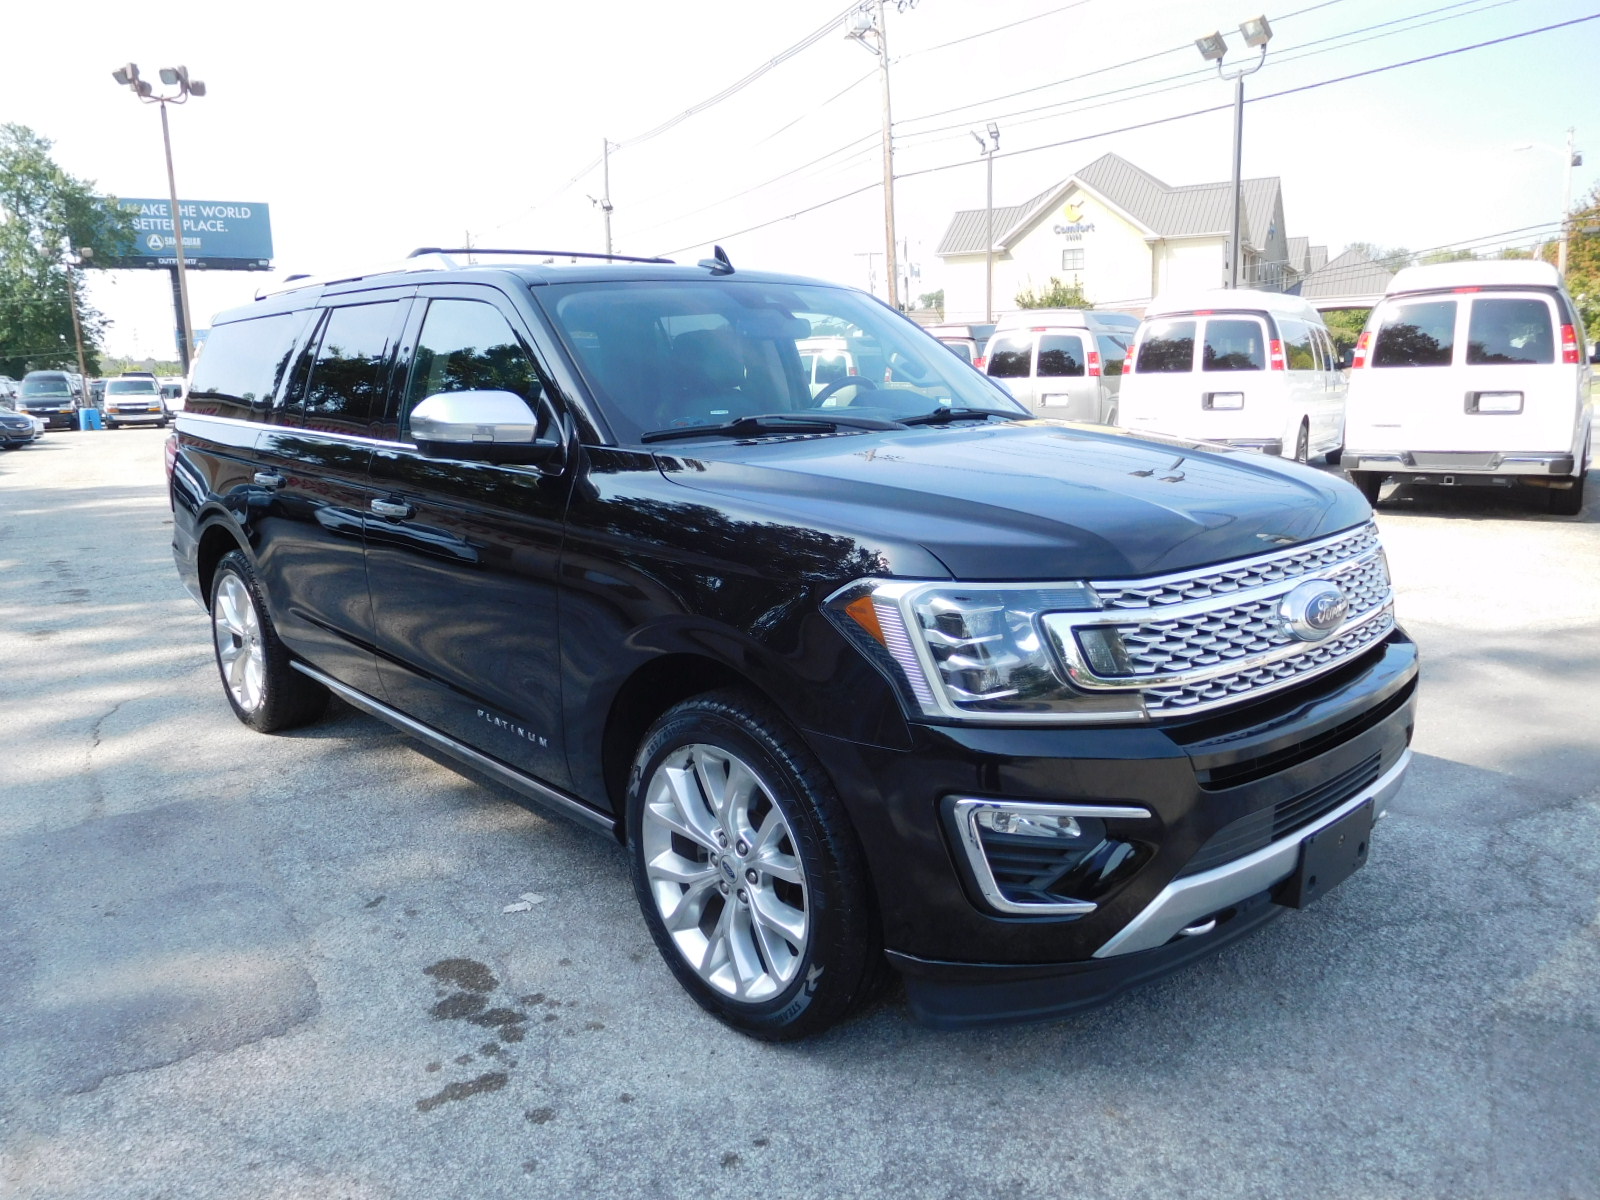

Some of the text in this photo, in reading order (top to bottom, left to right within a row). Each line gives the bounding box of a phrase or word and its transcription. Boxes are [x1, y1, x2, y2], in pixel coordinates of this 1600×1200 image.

[128, 202, 167, 217] AKE
[171, 205, 196, 218] HE
[200, 205, 251, 219] WORLD
[183, 219, 229, 232] PLACE.
[477, 709, 547, 748] PLATINUM
